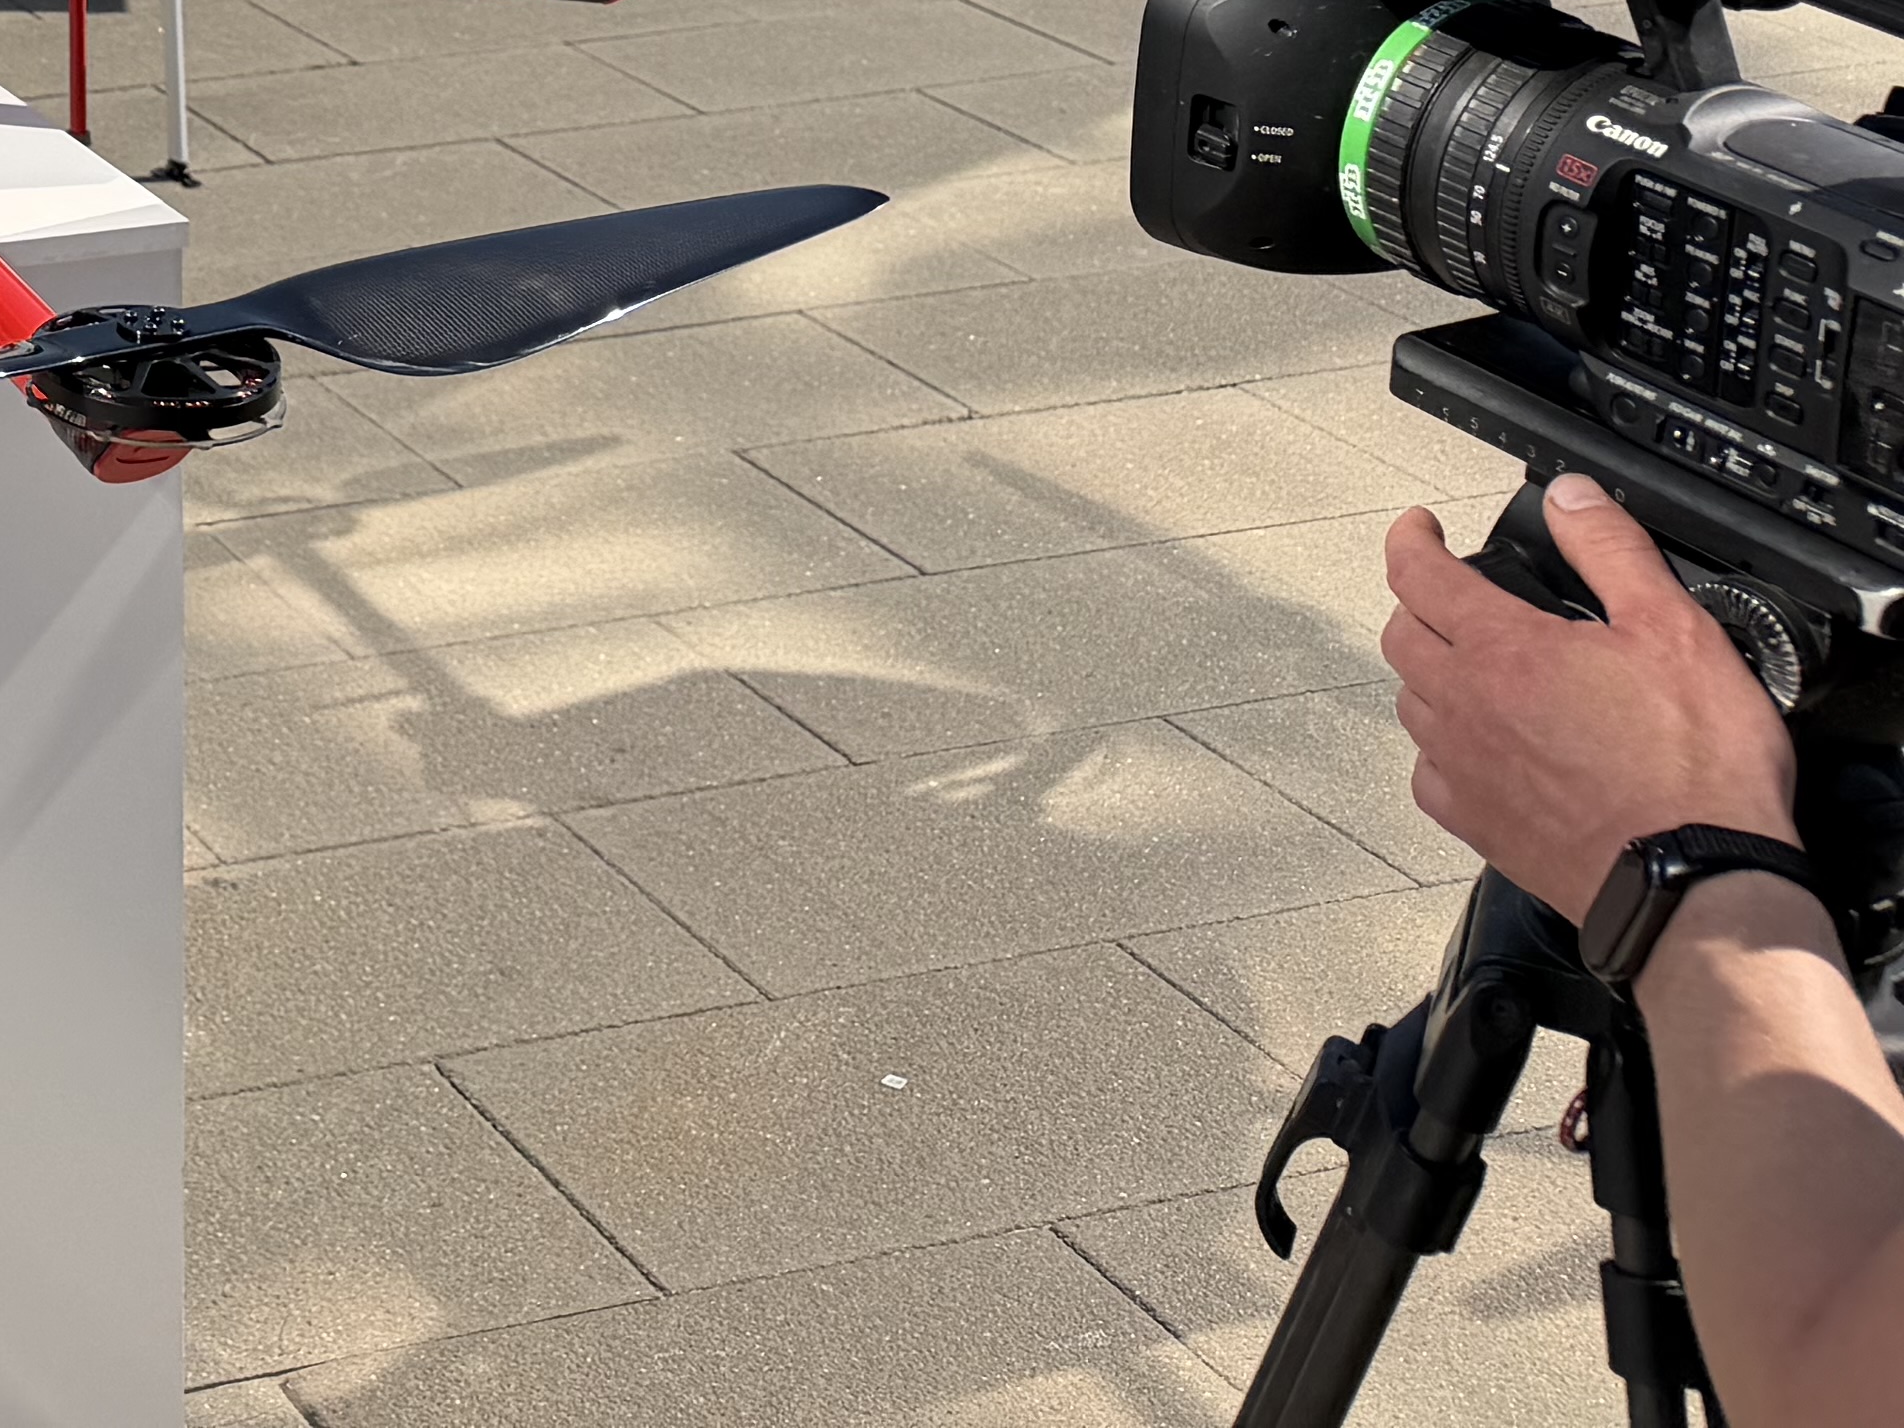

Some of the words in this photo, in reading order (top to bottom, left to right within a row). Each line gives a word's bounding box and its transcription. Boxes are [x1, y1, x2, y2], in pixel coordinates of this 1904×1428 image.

[1260, 125, 1295, 137] CLOSED
[1585, 114, 1669, 159] Canon
[1555, 459, 1566, 472] 2
